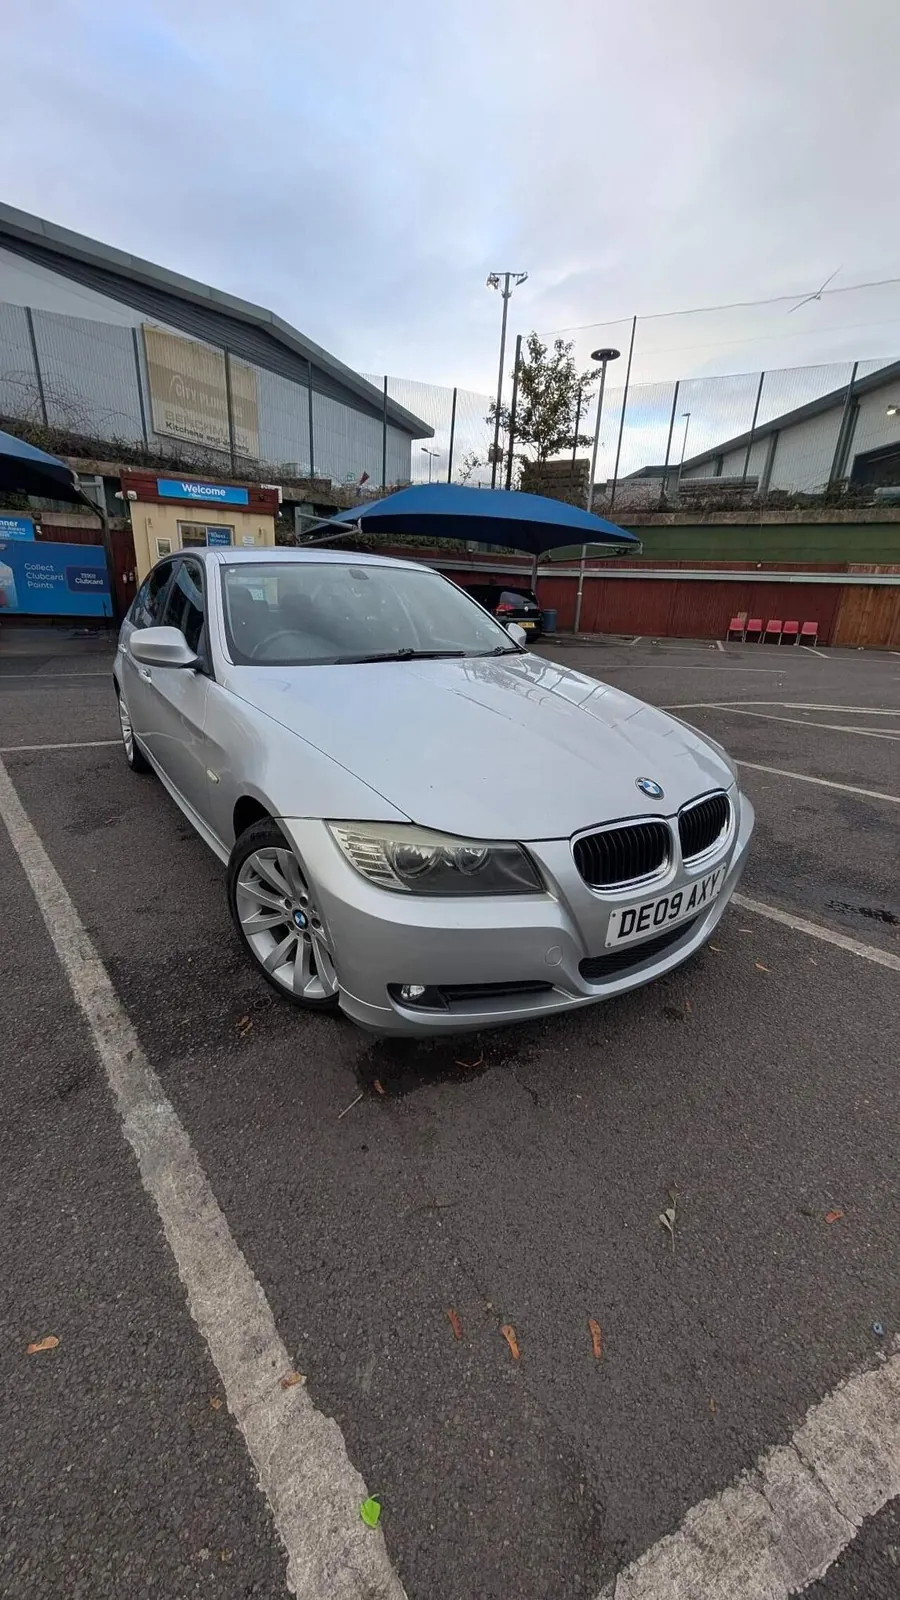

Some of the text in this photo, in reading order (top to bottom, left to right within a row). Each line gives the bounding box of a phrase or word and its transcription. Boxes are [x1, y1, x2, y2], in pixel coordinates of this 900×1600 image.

[165, 421, 204, 439] Kitchens
[206, 435, 221, 444] and
[181, 483, 226, 497] Welcome
[24, 562, 54, 571] Collect
[26, 571, 64, 581] Clubcard
[75, 577, 104, 585] Clubcard
[27, 581, 54, 589] Points
[617, 869, 721, 938] DE09 AXY
